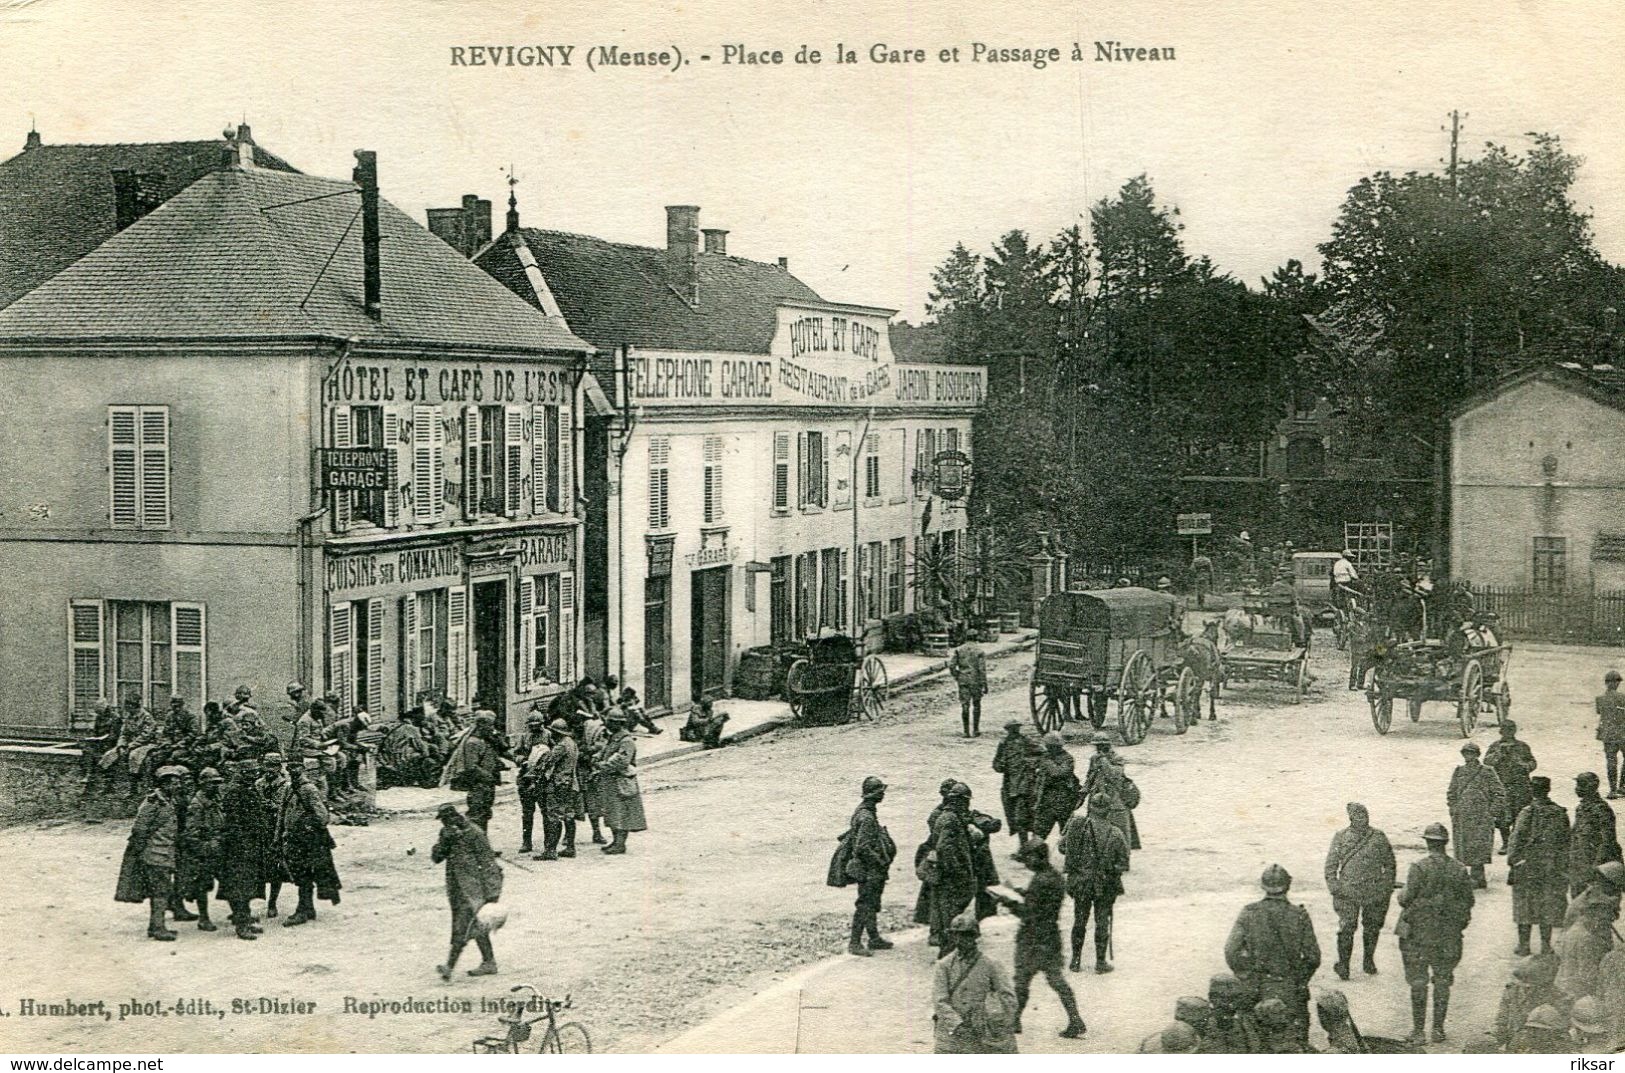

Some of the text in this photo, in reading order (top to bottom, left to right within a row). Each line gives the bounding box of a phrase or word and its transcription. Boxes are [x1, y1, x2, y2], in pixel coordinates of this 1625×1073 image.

[832, 317, 847, 352] ET
[405, 367, 429, 401] ET
[493, 369, 515, 402] DE
[525, 370, 568, 403] L'EST
[627, 358, 712, 398] TELEPHONE
[778, 357, 848, 402] RESTAURANT
[895, 369, 982, 402] JARDIN BOSQUETS
[327, 451, 387, 468] TELEPHONE
[329, 471, 384, 488] GARAGE
[327, 556, 377, 592] CUISINE
[399, 547, 460, 583] COMMANDE
